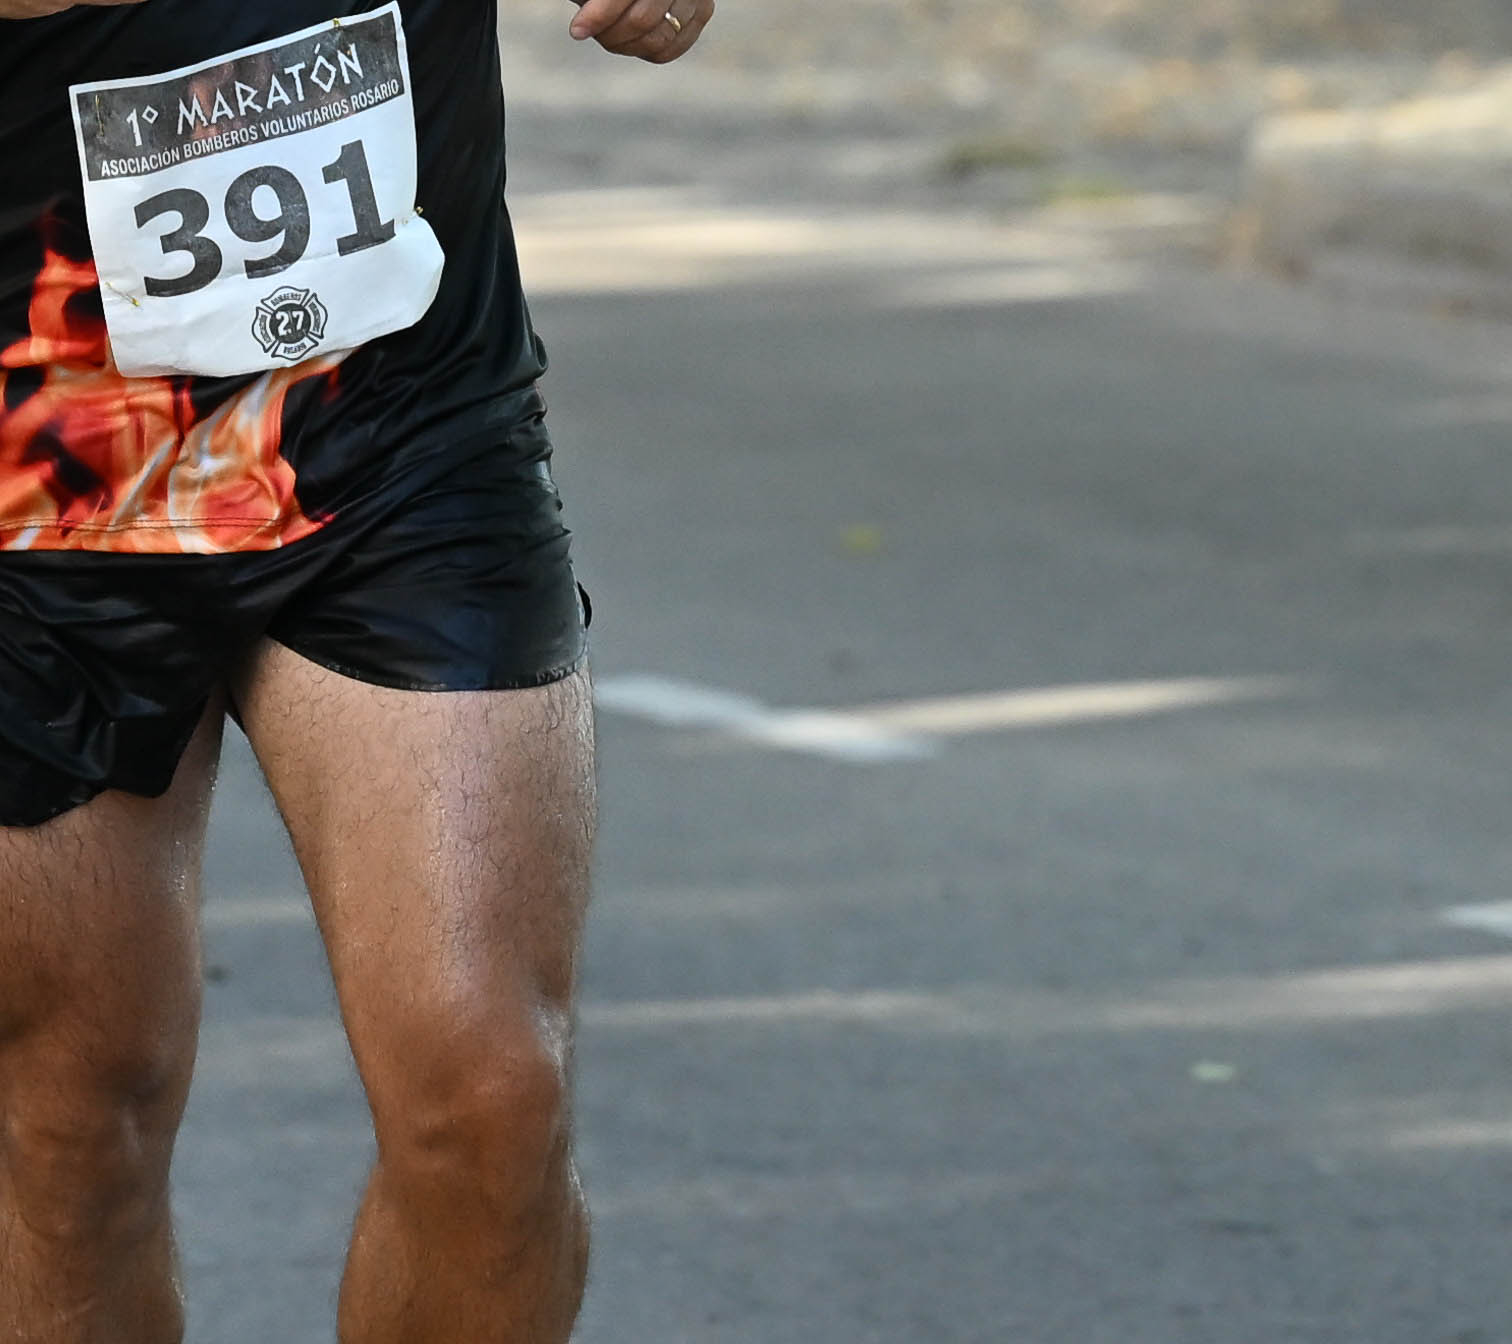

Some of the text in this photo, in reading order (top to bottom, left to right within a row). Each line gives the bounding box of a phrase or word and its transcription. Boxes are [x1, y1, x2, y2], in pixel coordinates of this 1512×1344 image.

[101, 78, 400, 178] ASOCIACIÓN BOMBEROS VOLUNTARIOS ROSARIO
[177, 42, 364, 136] MARATÓN
[133, 139, 396, 298] 391
[275, 310, 304, 337] 27
